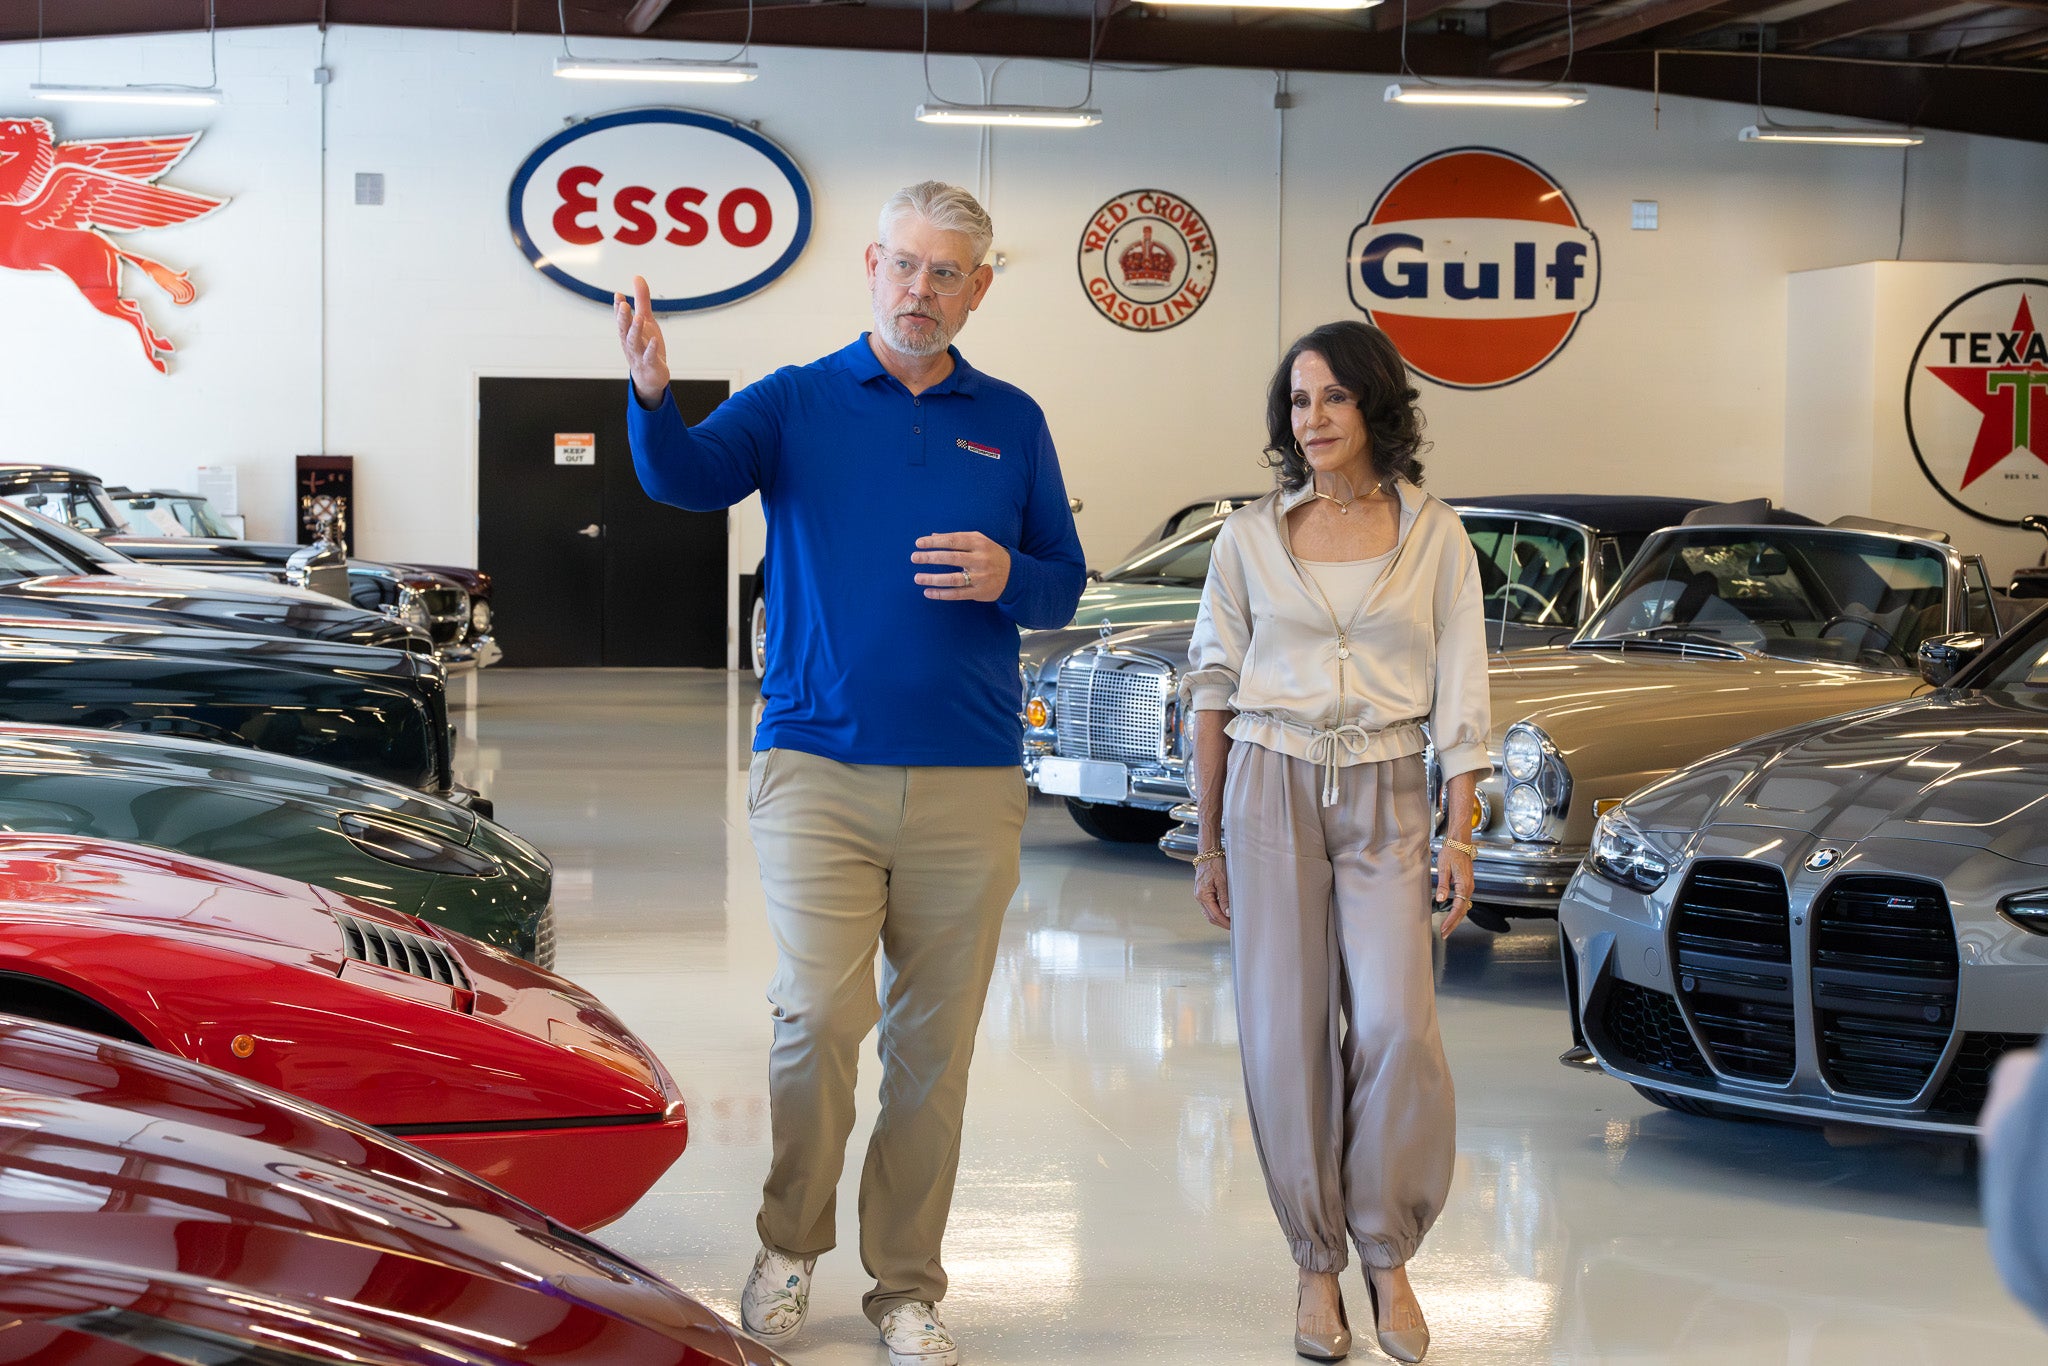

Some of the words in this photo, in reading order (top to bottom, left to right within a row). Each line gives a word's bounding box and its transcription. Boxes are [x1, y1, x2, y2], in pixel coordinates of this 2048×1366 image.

[552, 165, 773, 248] Esso
[1085, 202, 1129, 251] RED
[1136, 194, 1210, 253] CROWN
[1360, 232, 1587, 300] Gulf
[1088, 277, 1207, 327] GASOLINE
